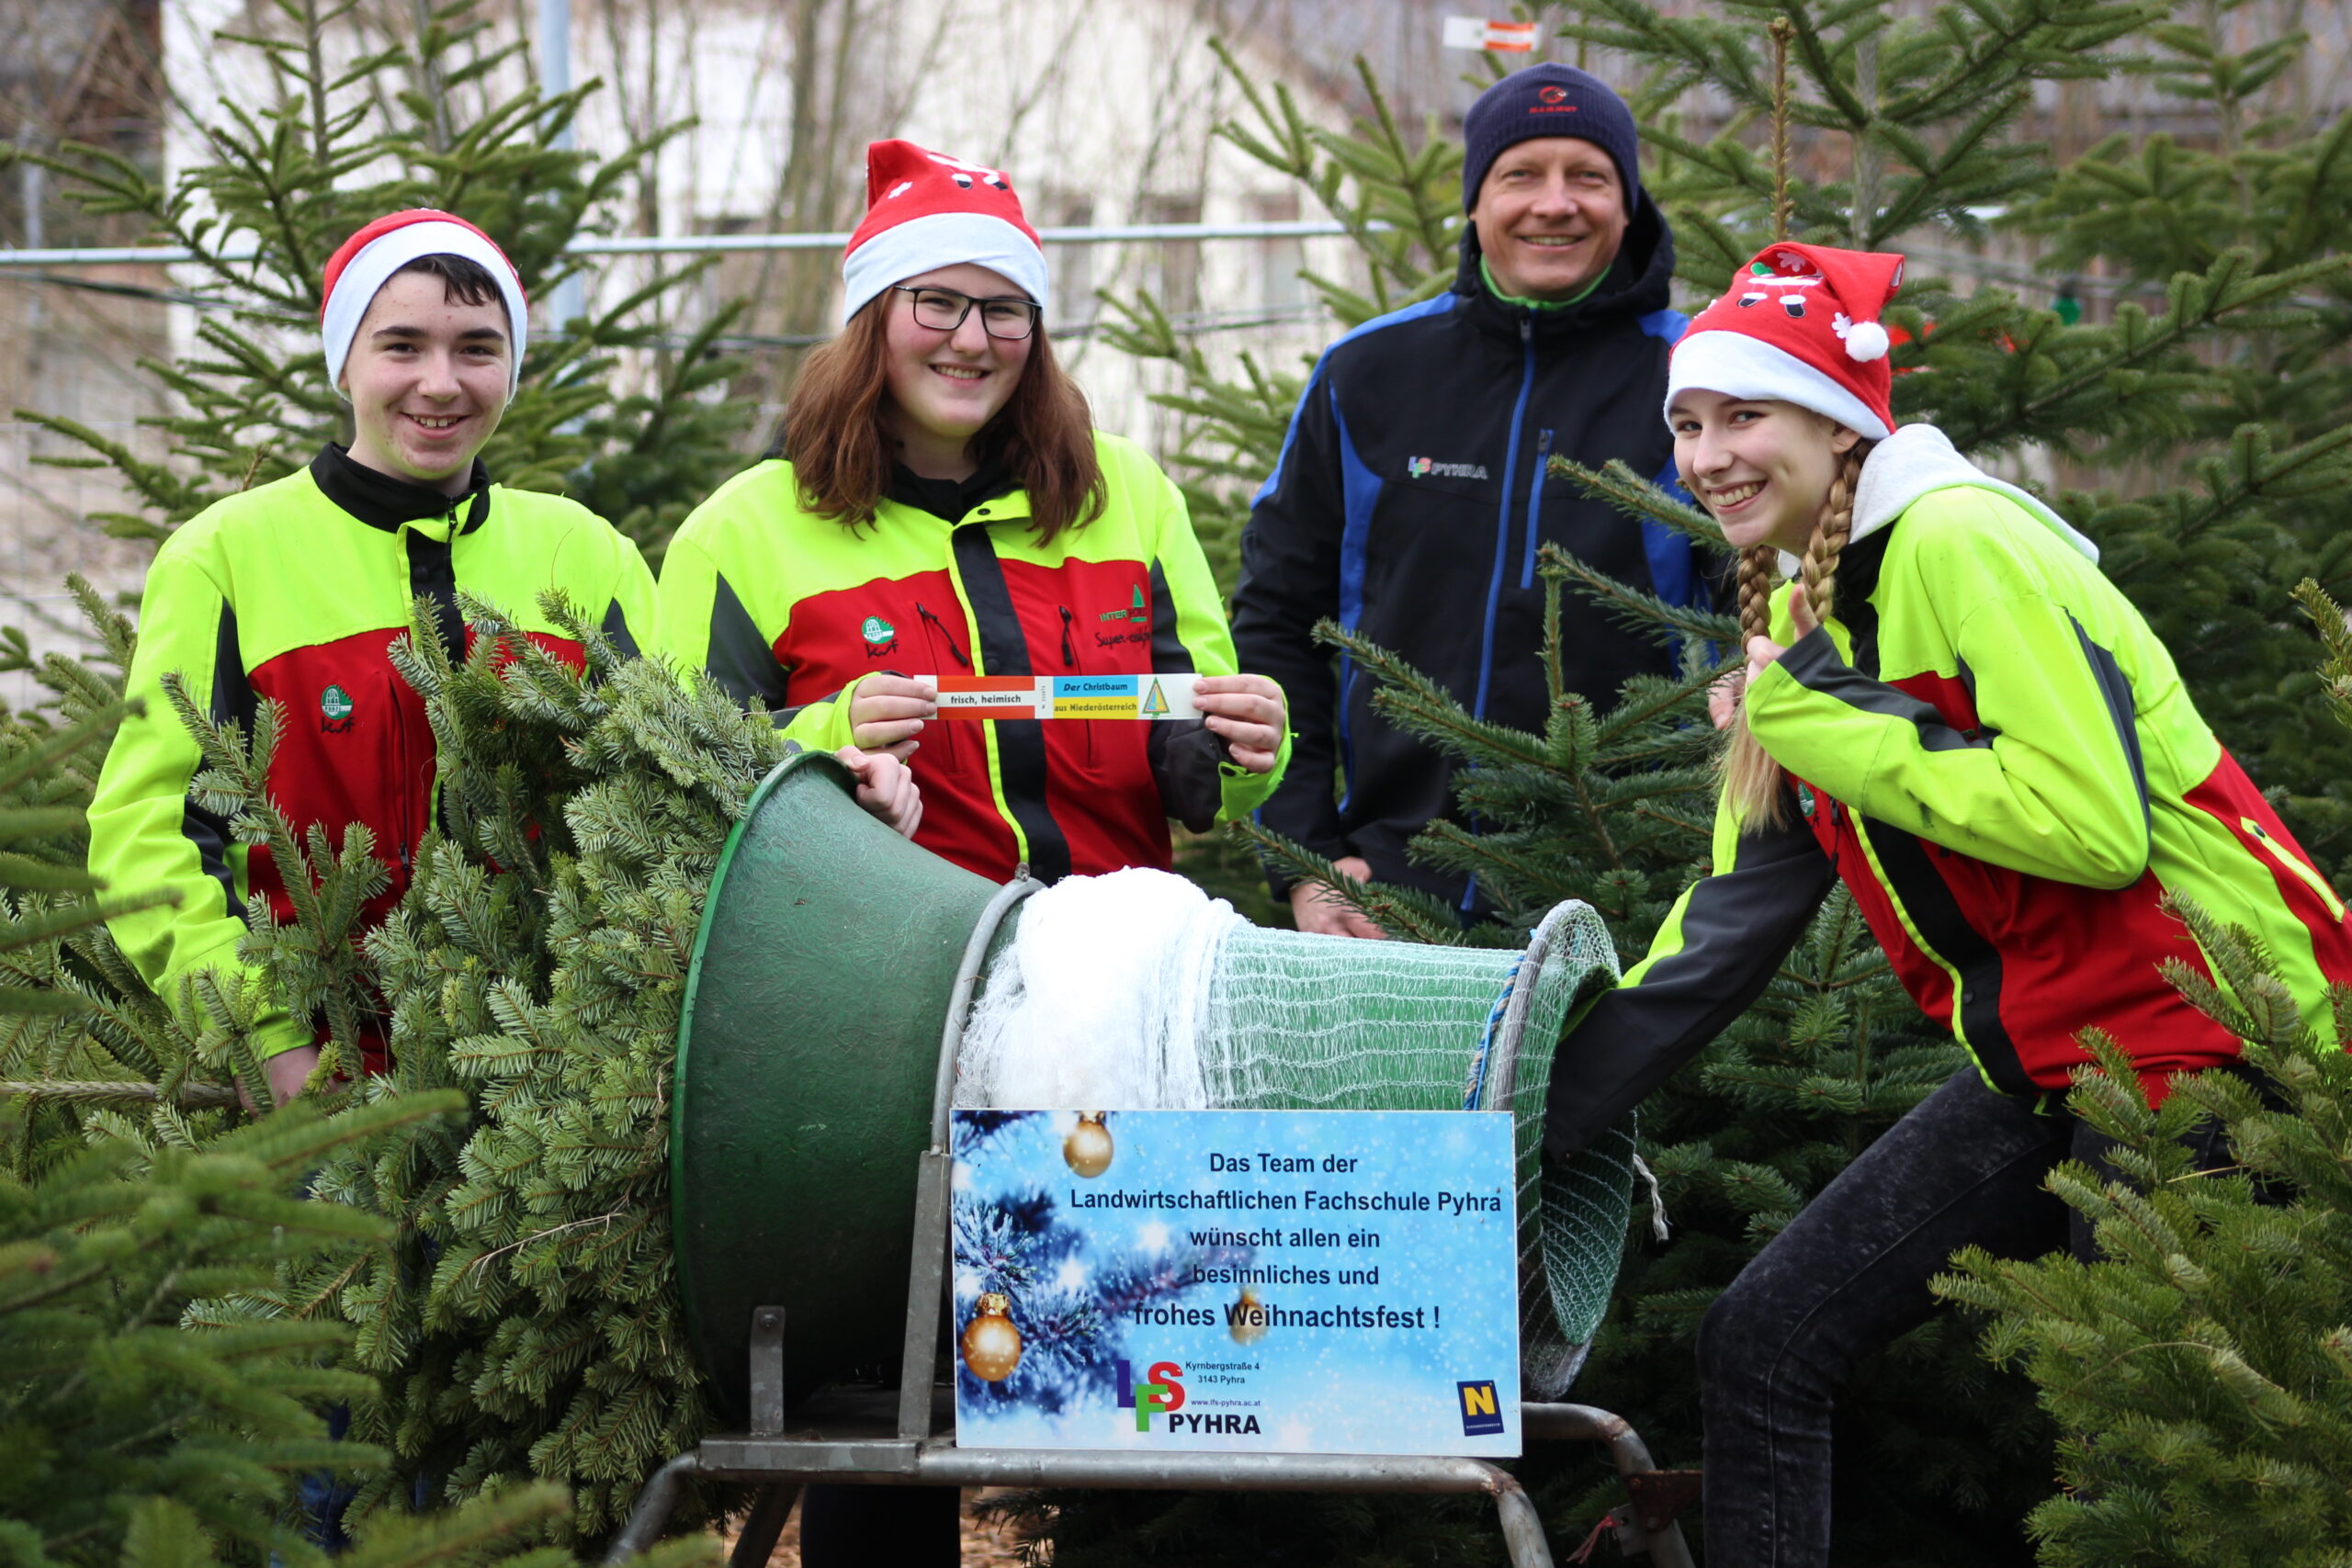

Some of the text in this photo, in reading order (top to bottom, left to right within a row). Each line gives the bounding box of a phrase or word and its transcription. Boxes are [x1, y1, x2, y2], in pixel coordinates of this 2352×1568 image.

[1431, 462, 1487, 479] PYHRA
[1083, 682, 1128, 691] Christbaum
[951, 694, 1022, 705] frisch, heimisch
[1069, 703, 1136, 712] Niederösterreich
[1209, 1153, 1358, 1173] Das Team der
[1070, 1190, 1501, 1216] Landwirtschaftlichen Fachschule Pyhra
[1190, 1227, 1380, 1248] wünscht allen ein
[1193, 1264, 1379, 1285] besinnliches und
[1135, 1303, 1440, 1328] frohes Weihnachtsfest !
[1185, 1361, 1252, 1372] Kyrnbergstraße
[1198, 1375, 1245, 1385] 3143 Pyhra
[1191, 1399, 1261, 1408] www.lfs-pyhra.ac.at
[1464, 1386, 1496, 1416] N
[1169, 1414, 1261, 1434] PYHRA
